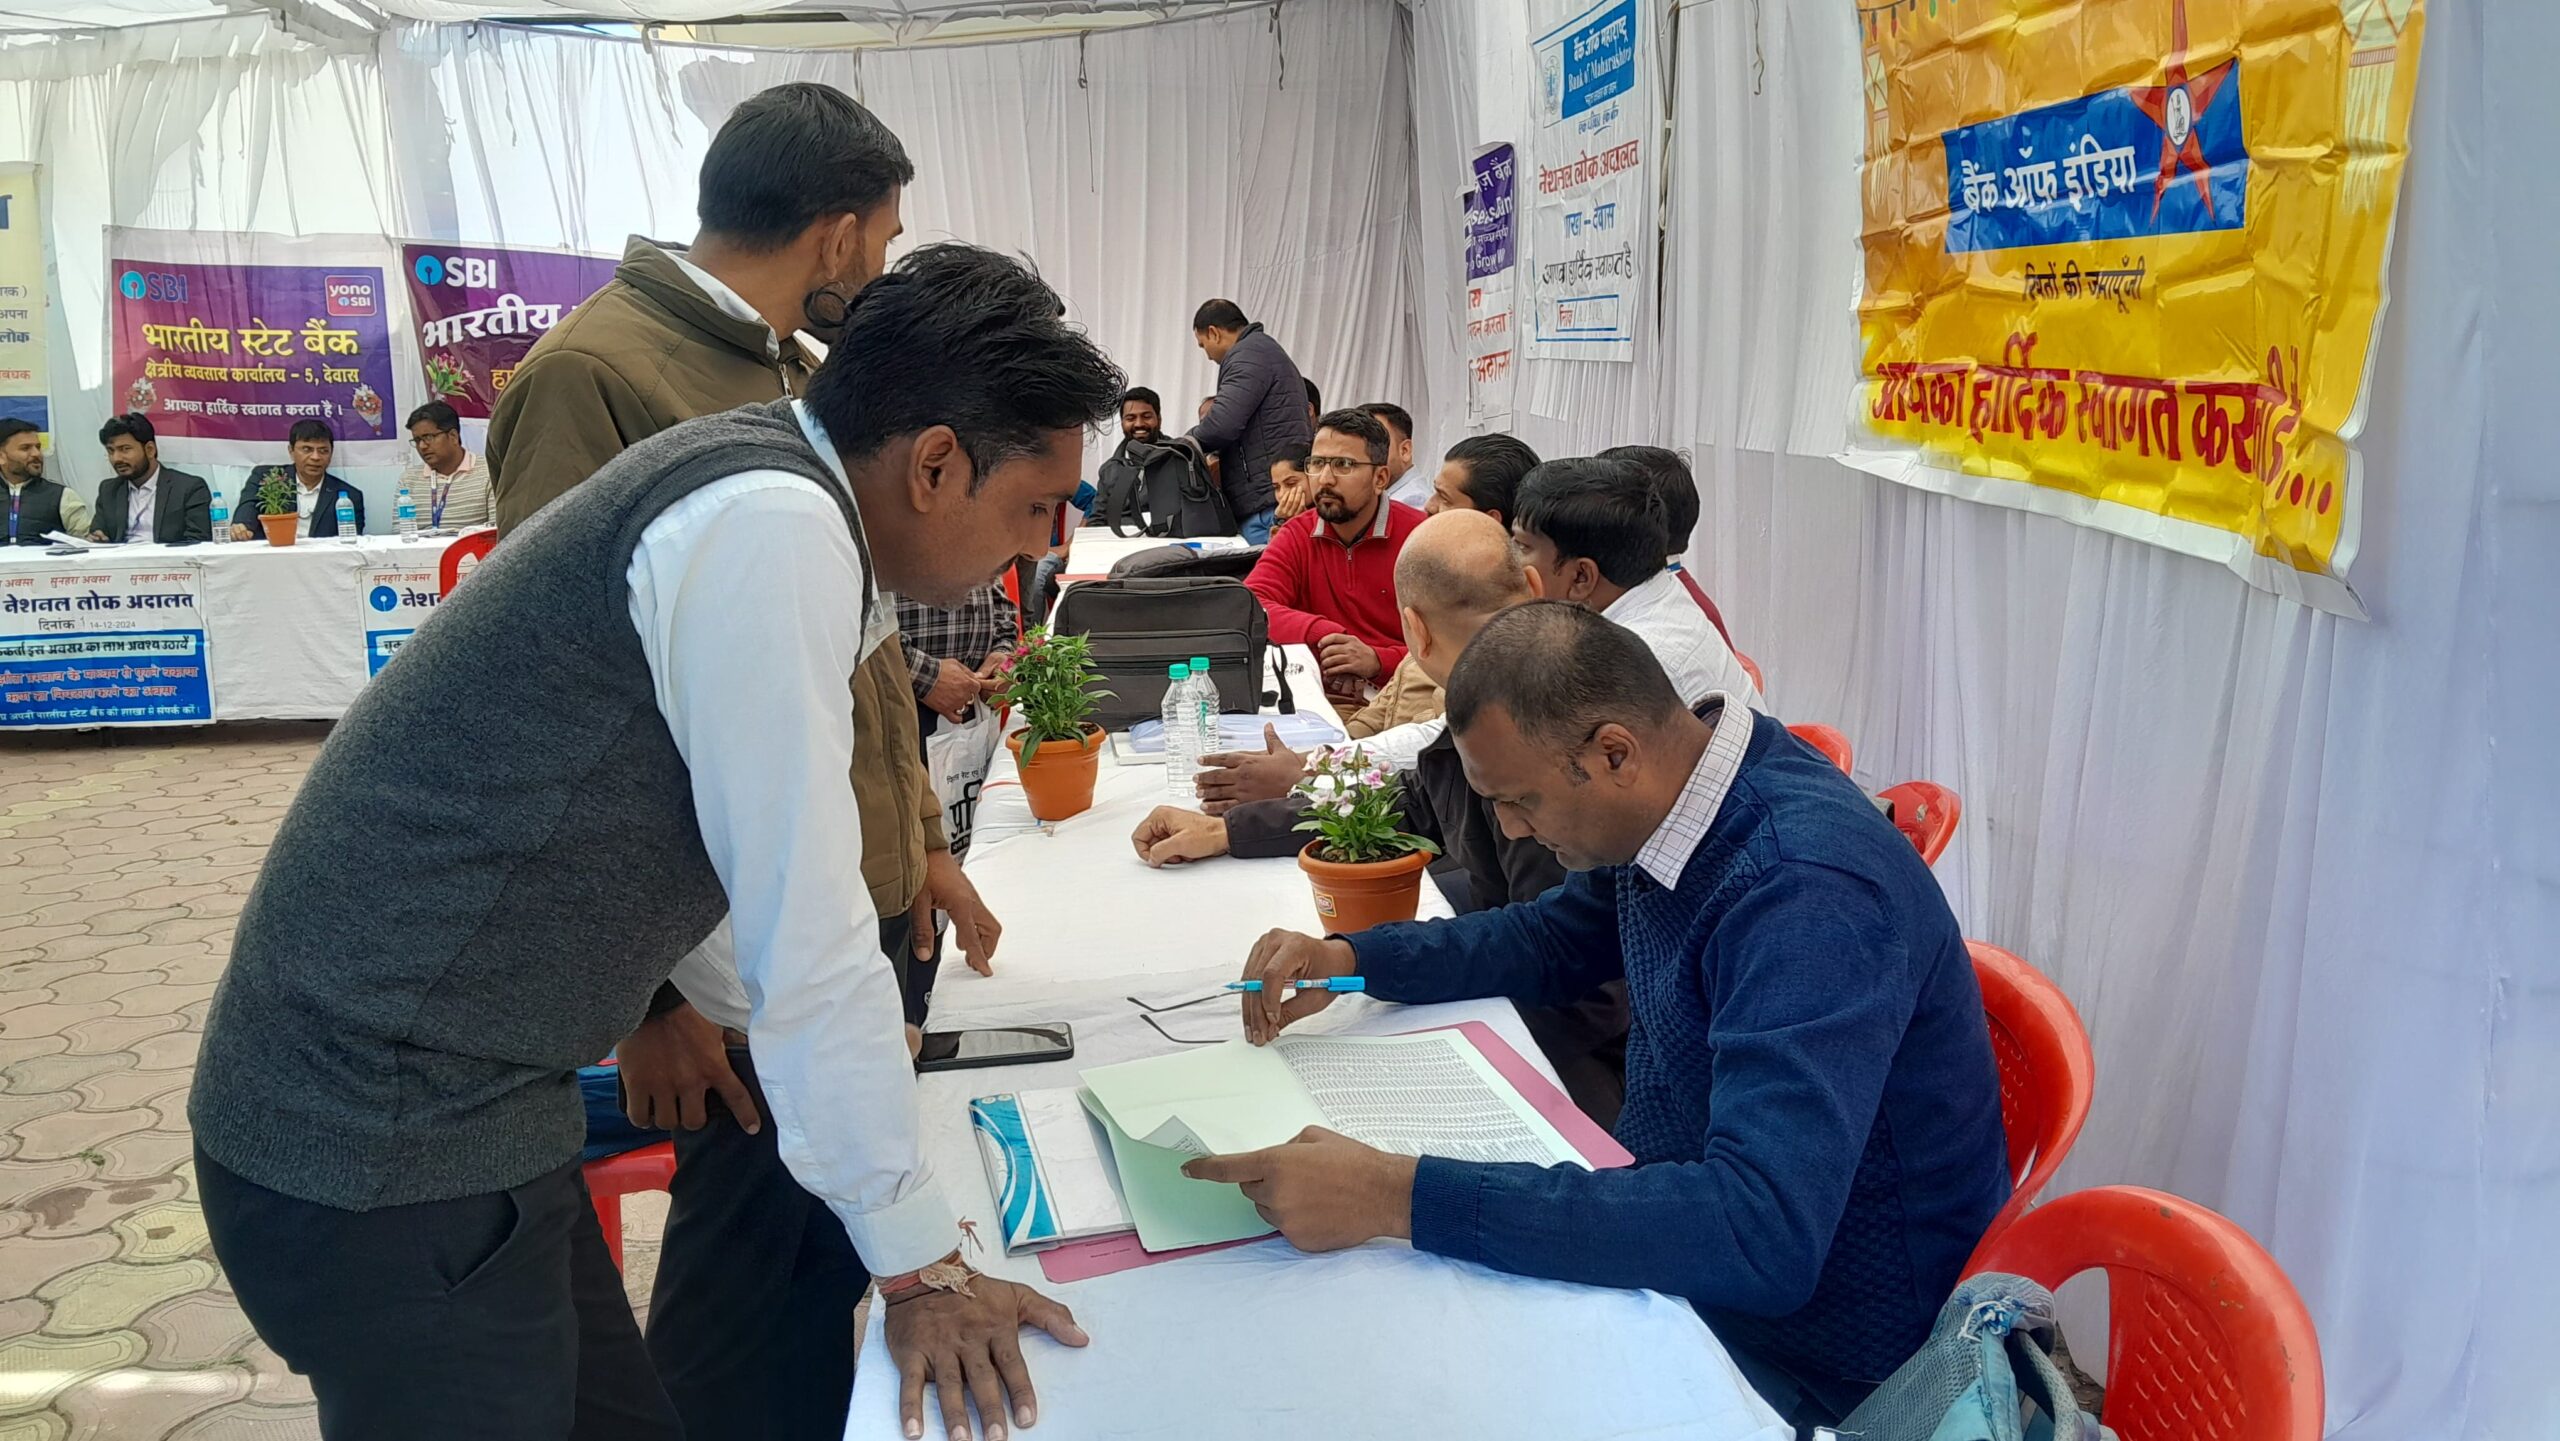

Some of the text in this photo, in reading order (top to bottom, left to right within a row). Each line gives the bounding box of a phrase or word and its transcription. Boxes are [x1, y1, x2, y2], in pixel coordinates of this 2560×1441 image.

[1568, 46, 1632, 92] Bank of Maharashtra
[1539, 139, 1639, 194] नेशनल लोक अदालत
[1961, 160, 1999, 214] बैंक
[2063, 133, 2137, 213] इंडिया
[445, 257, 497, 289] SBI
[1475, 251, 1497, 270] Grow
[147, 273, 188, 302] SBI
[329, 283, 371, 297] yono
[2062, 260, 2082, 300] की
[350, 296, 371, 306] SBI
[422, 293, 563, 348] भारतीय
[142, 317, 359, 355] भारतीय स्टेट बैंक
[184, 363, 228, 382] व्यवसाय
[231, 362, 287, 383] कार्यालय
[304, 367, 320, 386] 5,
[323, 363, 360, 383] देवास
[163, 398, 202, 413] आपका
[206, 400, 239, 415] हार्दिक
[241, 403, 282, 416] स्वागत
[285, 404, 320, 416] करता
[323, 400, 334, 418] है
[1872, 361, 1972, 428] आपका
[1969, 331, 2070, 445] हार्दिक
[2075, 370, 2183, 462] स्वागत
[50, 575, 79, 588] सुनहरा
[82, 575, 112, 584] अवसर
[129, 573, 159, 586] सुनहरा
[162, 573, 192, 583] अवसर
[4, 590, 194, 614] नेशनल लोक अदालत
[38, 617, 136, 631] दिनांक 14-12-2024
[27, 646, 45, 658] इस
[47, 642, 83, 655] अवसर
[85, 641, 101, 652] का
[128, 639, 160, 651] अवश्य
